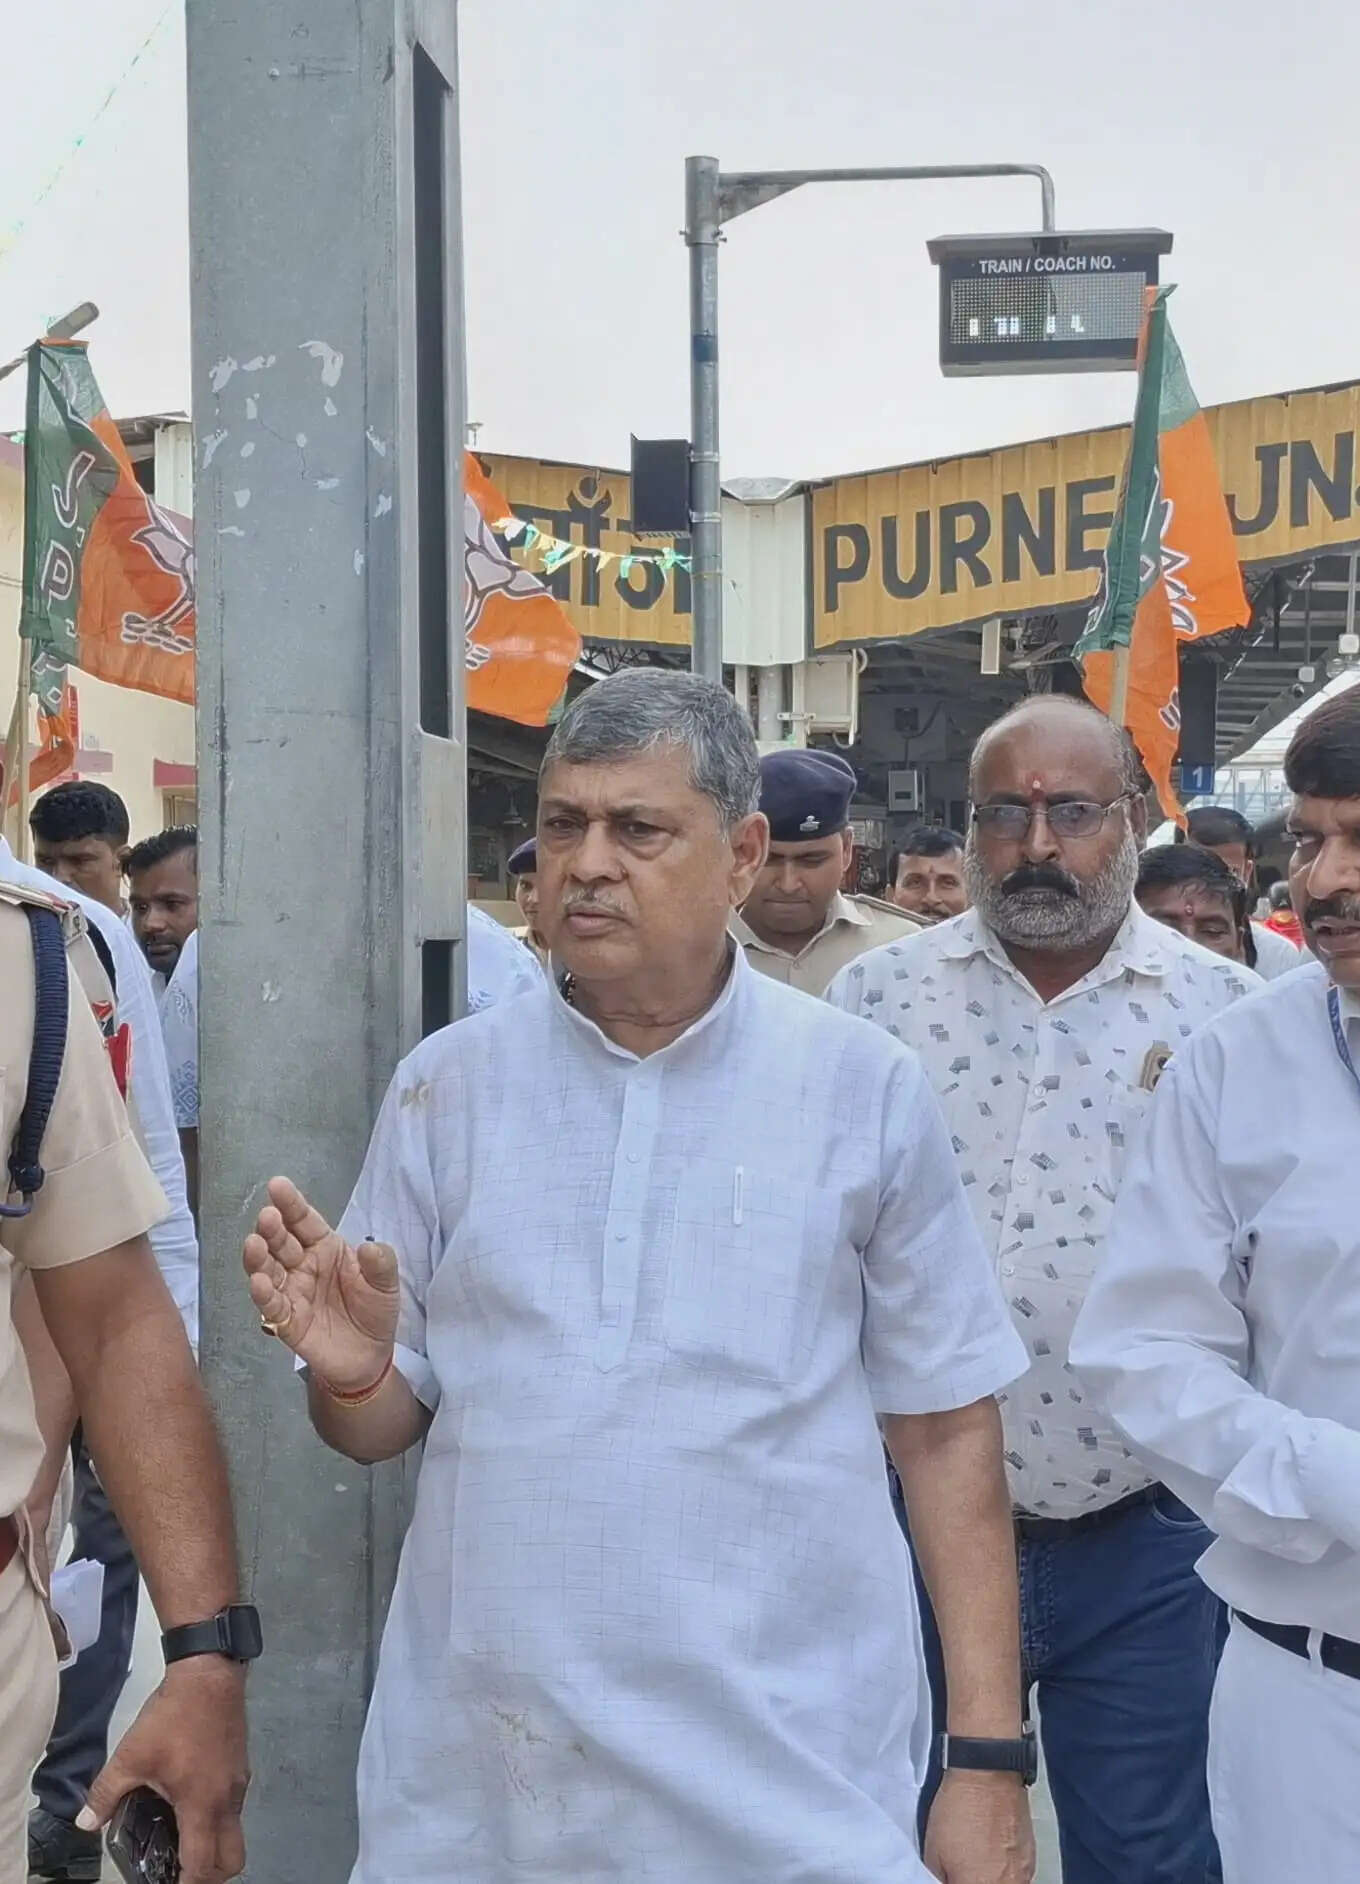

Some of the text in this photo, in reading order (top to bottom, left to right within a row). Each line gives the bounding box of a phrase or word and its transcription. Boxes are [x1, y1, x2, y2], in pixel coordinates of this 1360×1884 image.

[979, 255, 1116, 274] TRAIN / COACH NO.
[823, 475, 1116, 614] PURNE
[1192, 766, 1203, 788] 1
